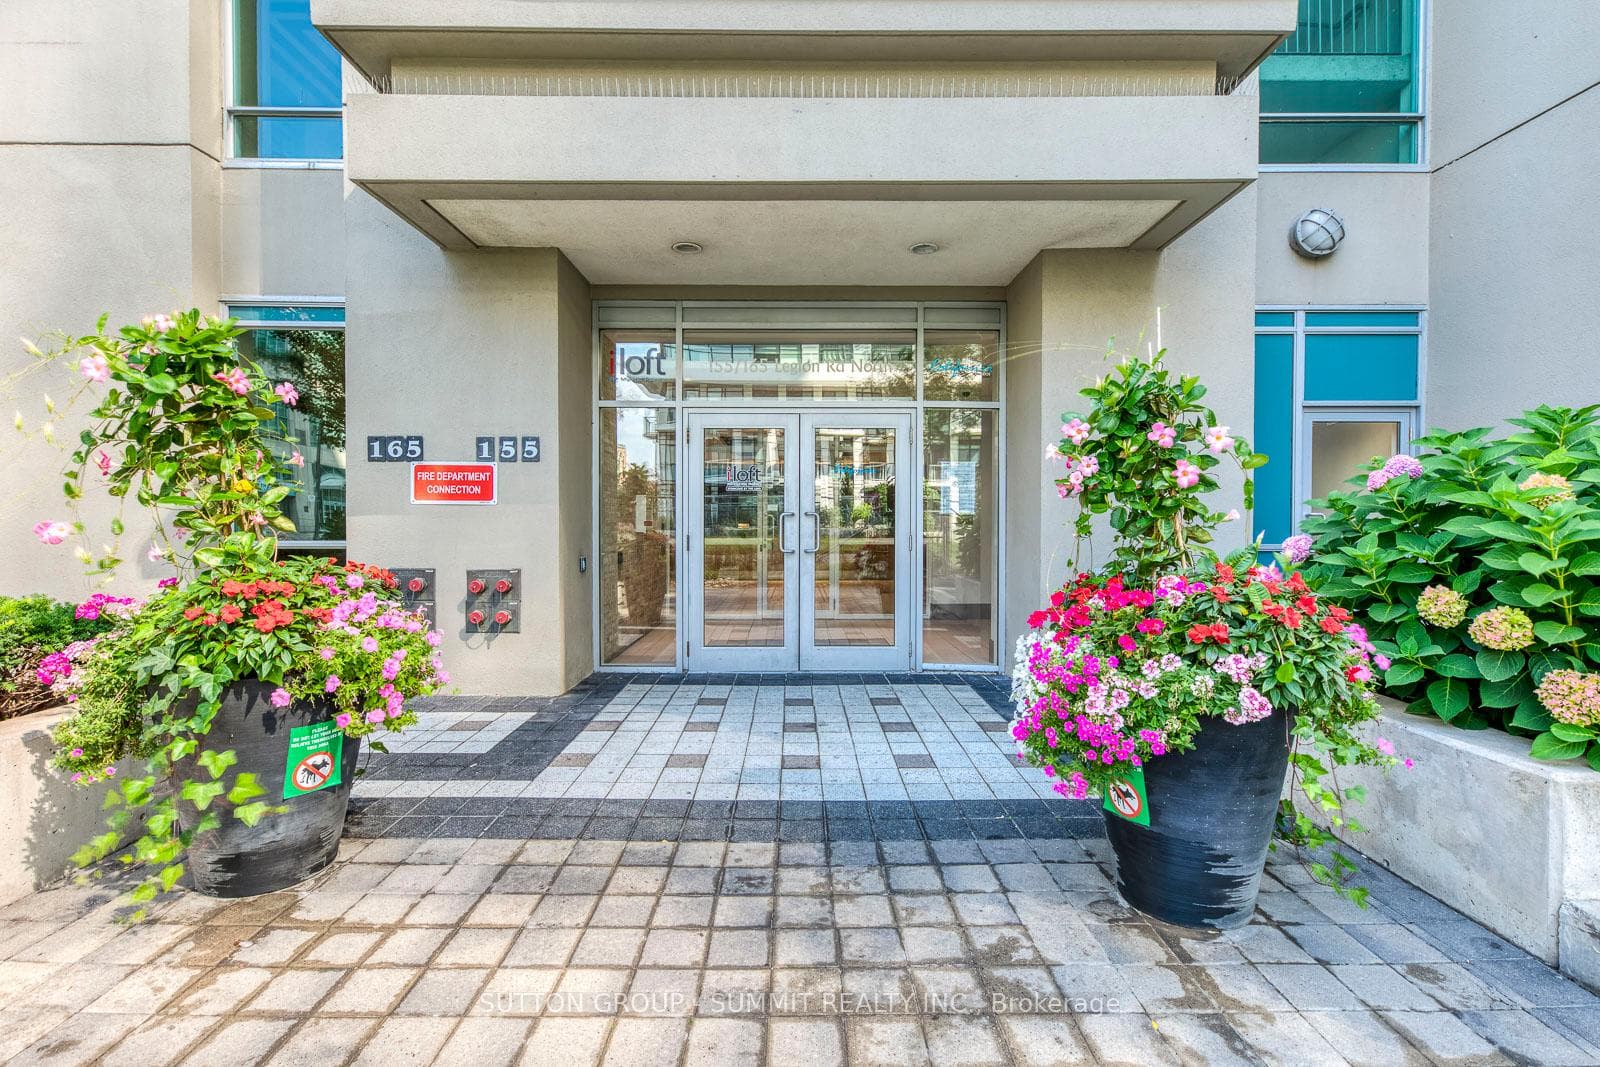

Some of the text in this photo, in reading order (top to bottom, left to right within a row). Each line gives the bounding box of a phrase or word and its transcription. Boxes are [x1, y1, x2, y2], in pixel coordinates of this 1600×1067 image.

[775, 357, 820, 375] Legion
[827, 357, 845, 373] Rd
[851, 355, 892, 373] North
[370, 440, 421, 458] 165
[479, 440, 538, 458] 155
[417, 471, 491, 481] FIRE DEPARTMENT
[426, 485, 481, 494] CONNECTION
